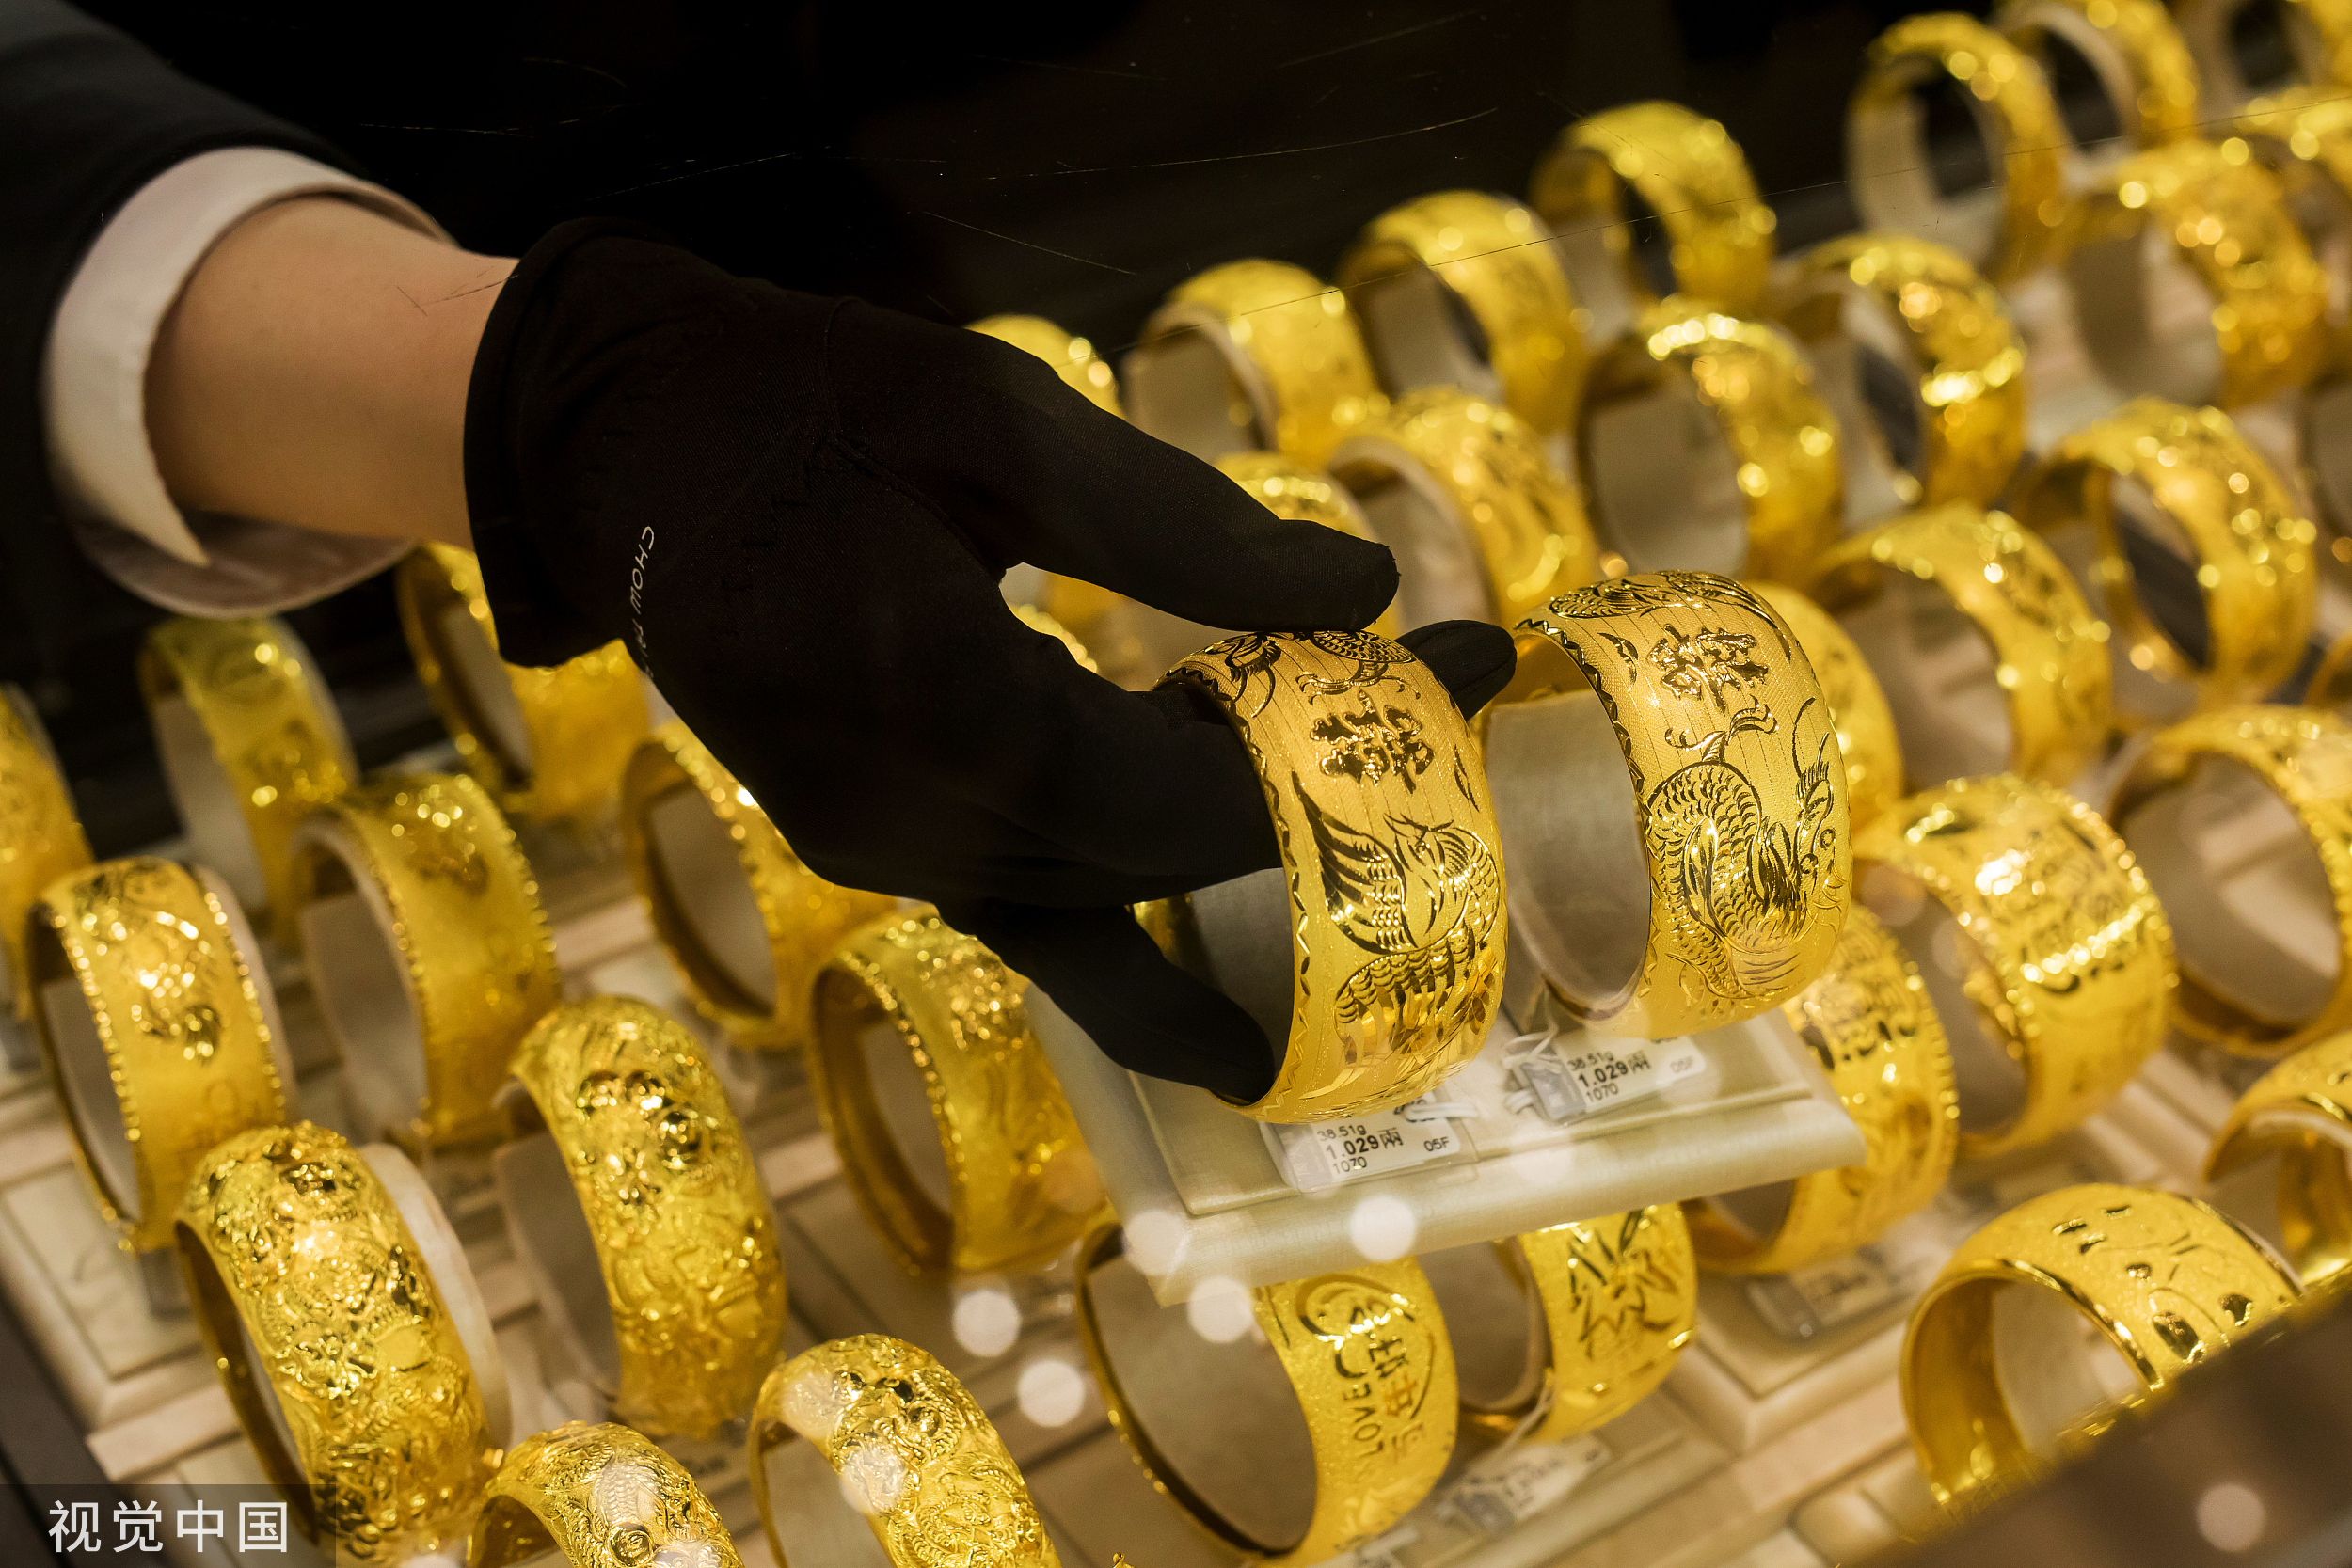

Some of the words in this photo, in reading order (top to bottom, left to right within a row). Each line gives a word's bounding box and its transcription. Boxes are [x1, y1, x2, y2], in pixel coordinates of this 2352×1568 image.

[630, 526, 655, 615] CHOW
[1568, 1051, 1614, 1071] 38.51g
[1586, 1083, 1619, 1102] 1070
[1317, 1125, 1367, 1141] 38.51g
[1423, 1136, 1450, 1152] 05F
[1332, 1156, 1368, 1174] 1070
[1342, 1382, 1384, 1458] LOVE
